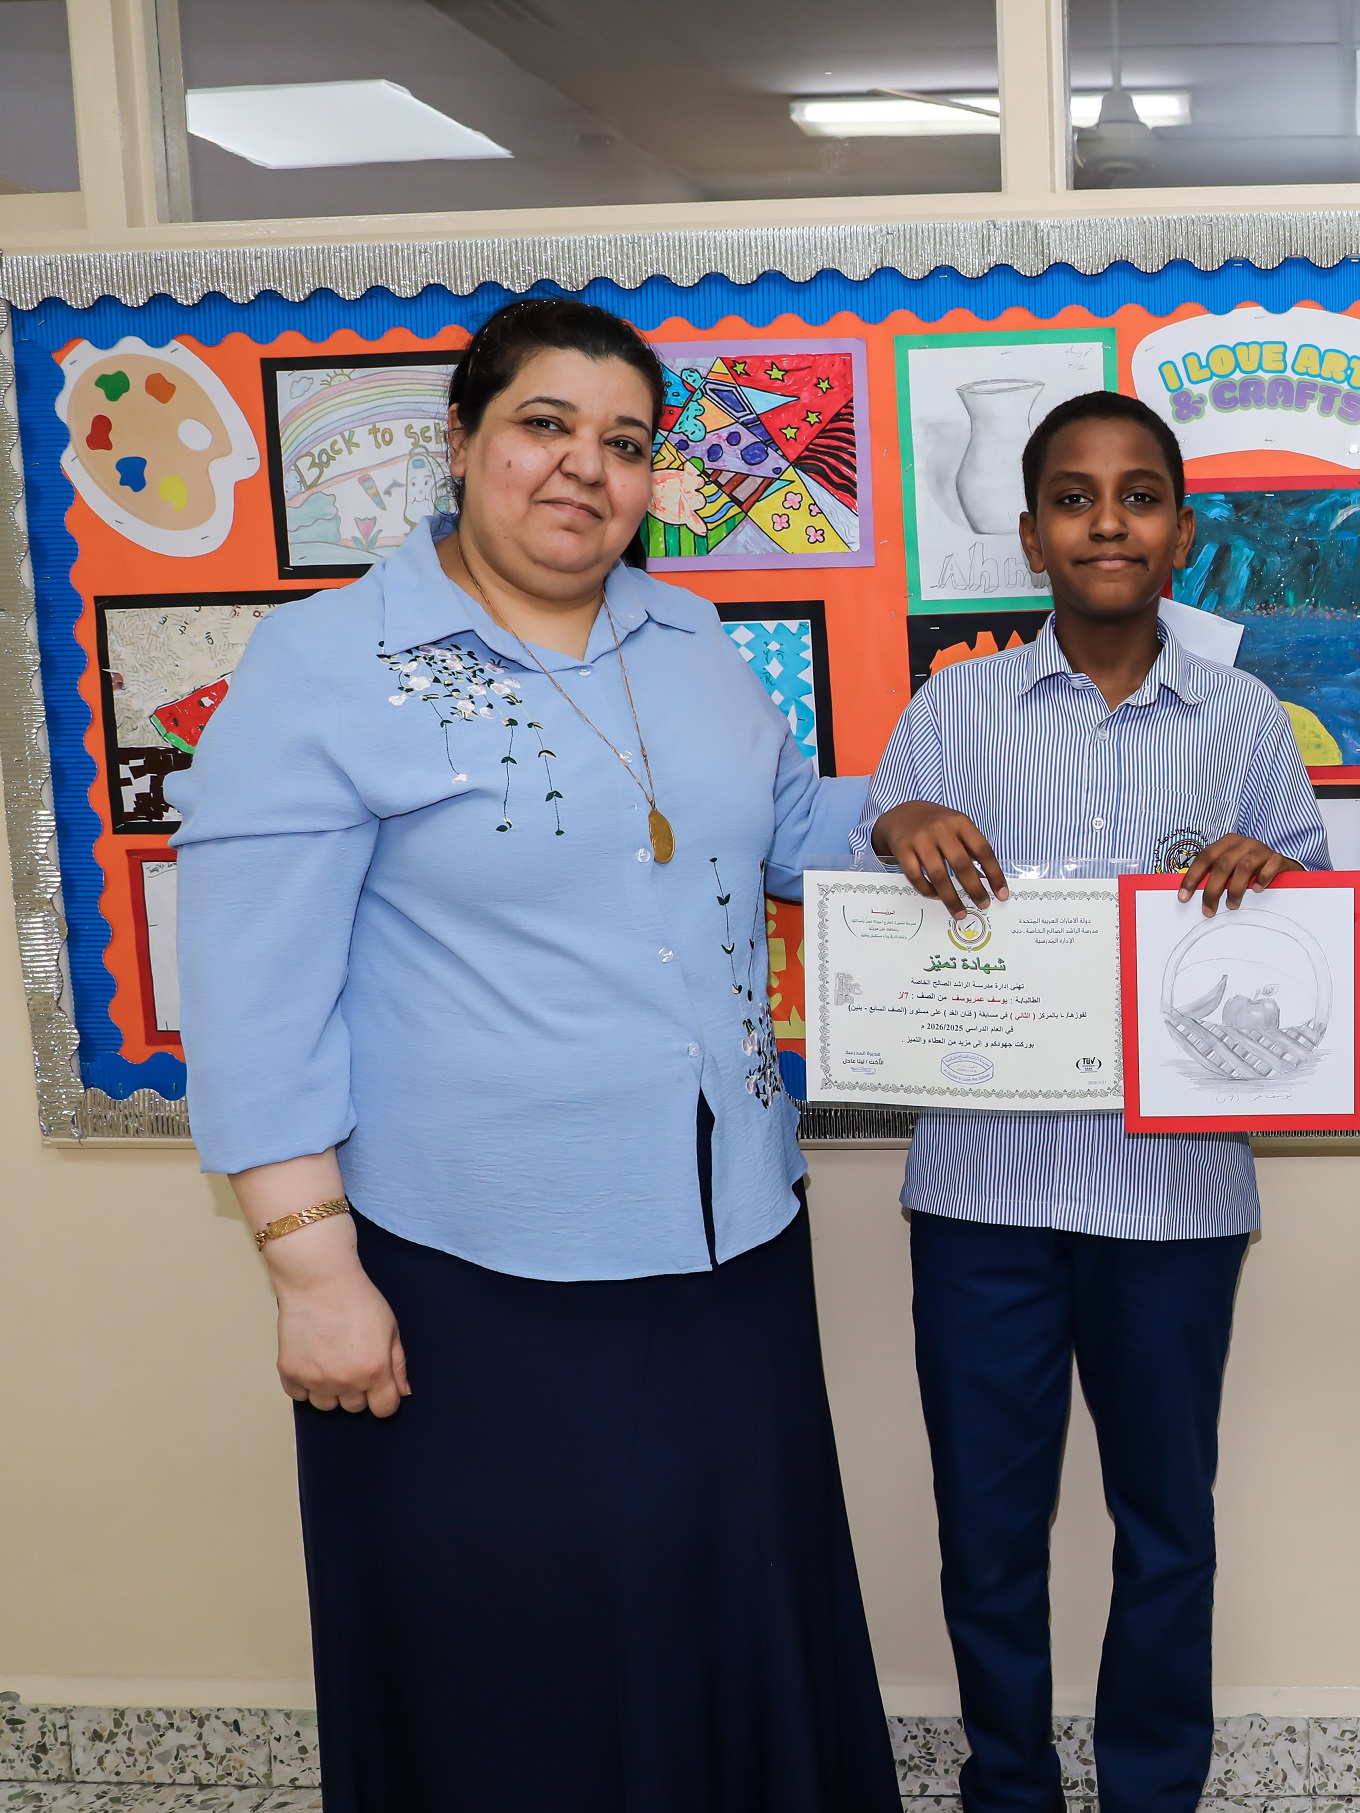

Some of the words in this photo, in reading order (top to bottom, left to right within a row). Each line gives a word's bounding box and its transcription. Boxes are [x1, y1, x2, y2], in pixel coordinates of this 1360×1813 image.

[1158, 361, 1184, 393] I
[1182, 341, 1287, 385] LOVE
[1170, 388, 1207, 424] &
[368, 423, 394, 449] to
[961, 957, 1006, 974] شهادة
[932, 980, 951, 988] الصالح
[954, 981, 970, 989] الراشد
[973, 981, 993, 989] مدرسة
[987, 996, 1007, 1004] يوسف
[870, 1005, 885, 1013] السابع
[979, 1010, 998, 1018] مسابقة
[1000, 1011, 1008, 1020] في
[1038, 1012, 1058, 1020] بالمركز
[966, 1025, 988, 1033] الدراسي
[1005, 1026, 1014, 1034] في
[958, 1038, 971, 1046] مزيد
[1015, 1040, 1035, 1048] بوركت
